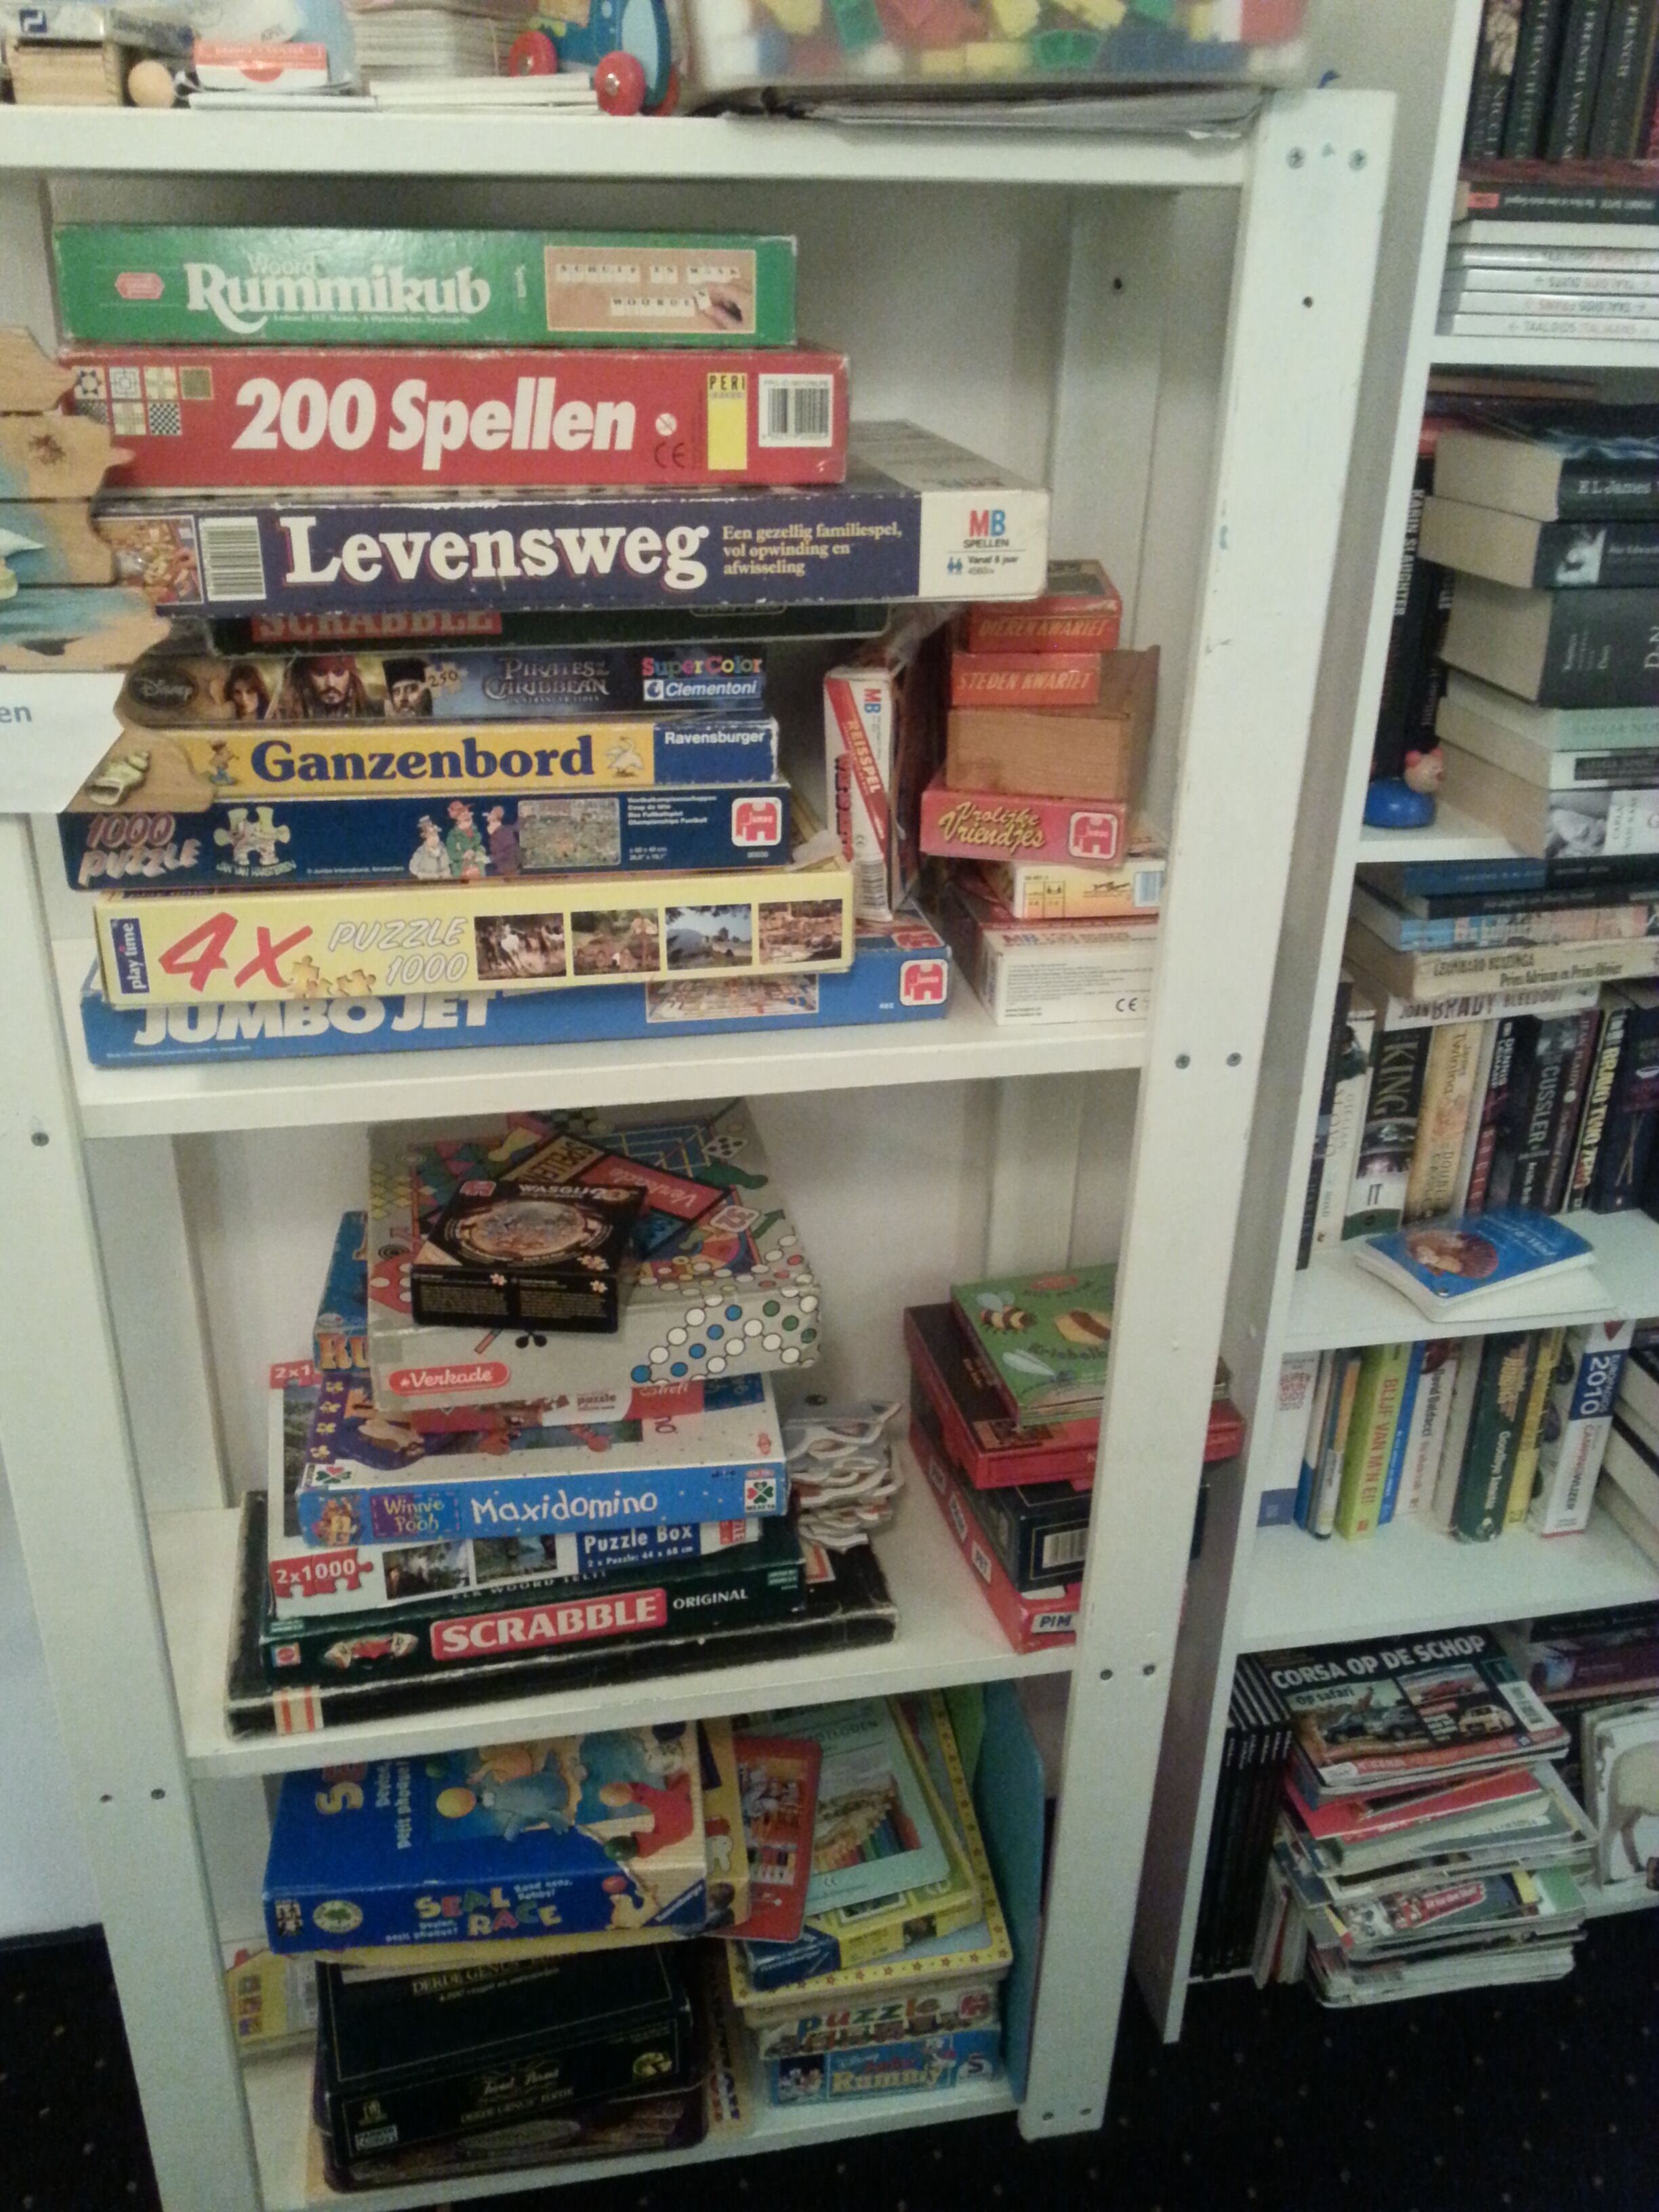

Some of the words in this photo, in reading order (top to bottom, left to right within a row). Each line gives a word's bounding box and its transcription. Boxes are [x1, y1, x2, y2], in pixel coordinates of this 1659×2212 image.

[184, 263, 490, 333] Rummikub
[710, 375, 745, 390] PERI
[232, 377, 377, 450] 200
[388, 377, 636, 470] Spellen
[722, 526, 753, 541] Een
[756, 525, 813, 543] gezellig
[816, 523, 903, 540] familiespel,
[969, 510, 1006, 537] MB
[279, 515, 710, 592] Levensweg
[723, 544, 745, 558] vol
[750, 544, 829, 560] opwinding
[832, 545, 850, 556] en
[963, 539, 1010, 549] SPELLEN
[723, 560, 806, 577] afwisseling
[1394, 537, 1416, 615] SLAUGHTER
[428, 671, 457, 688] 250
[499, 657, 595, 679] PIRATES
[484, 678, 610, 699] CARIBBEAN
[665, 680, 757, 699] Clementoni
[864, 689, 882, 714] MB
[664, 730, 766, 746] Ravensburger
[251, 735, 595, 783] Ganzenbord
[847, 720, 881, 794] REISSPEL
[86, 813, 176, 848] 1000
[938, 811, 1045, 854] Vriendjes
[119, 922, 142, 951] time
[329, 916, 468, 951] PUZZLE
[122, 954, 148, 990] play
[386, 953, 468, 986] 1000
[134, 996, 386, 1046] JUMBO
[391, 990, 498, 1031] JET
[1372, 1040, 1419, 1118] KING
[1597, 1046, 1619, 1102] BRAVO
[1528, 1063, 1561, 1152] CUSSLER
[1588, 1102, 1607, 1148] TWO
[1366, 1183, 1383, 1206] IT
[409, 1366, 493, 1388] Verkade
[1580, 1355, 1612, 1415] 2010
[577, 1394, 617, 1405] puzzle
[1380, 1378, 1399, 1414] BLIJF
[1372, 1422, 1391, 1450] VAN
[384, 1497, 445, 1513] Winnie
[472, 1489, 658, 1524] Maxidomino
[395, 1515, 440, 1534] Pooh
[583, 1529, 648, 1553] Puzzle
[657, 1524, 693, 1544] Box
[274, 1559, 356, 1584] 2x1000
[672, 1588, 749, 1610] ORIGINAL
[443, 1595, 657, 1653] SCRABBLE
[1039, 1614, 1073, 1629] PIM
[1270, 1661, 1349, 1690] CORSA
[1350, 1653, 1381, 1677] OP
[1384, 1646, 1416, 1670] DE
[1417, 1635, 1486, 1664] SCHOP
[1316, 1684, 1355, 1702] safari
[413, 1885, 512, 1919] SEAL
[466, 1898, 562, 1936] RACE
[796, 1997, 941, 2041] puzzle
